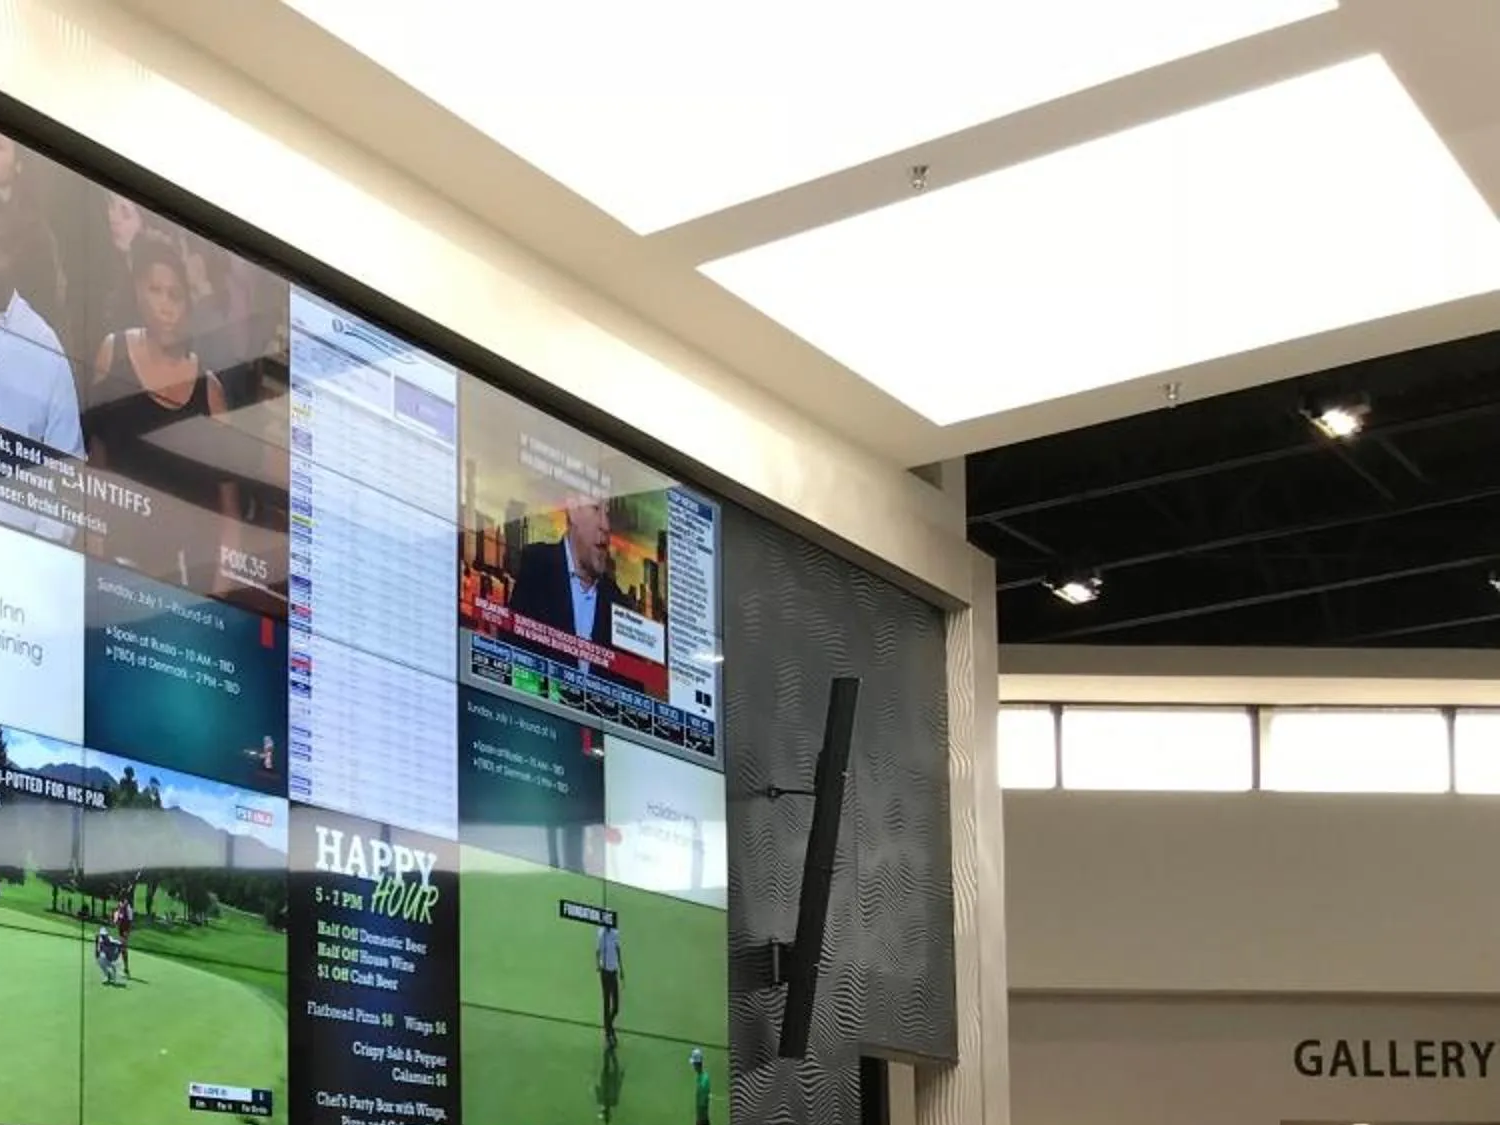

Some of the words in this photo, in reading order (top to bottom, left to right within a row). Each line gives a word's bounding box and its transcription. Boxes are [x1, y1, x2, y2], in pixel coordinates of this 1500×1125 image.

[62, 474, 152, 516] AINTIFFS
[0, 597, 25, 624] Inn
[45, 779, 64, 799] FOR
[67, 787, 82, 802] HIS
[315, 825, 437, 891] HAPPY
[315, 887, 323, 902] 5
[342, 891, 363, 911] PM
[371, 875, 439, 924] HOUR
[317, 920, 339, 937] Half
[342, 927, 359, 941] Off
[360, 929, 404, 949] Domestic
[317, 941, 339, 959] Half
[342, 949, 359, 962] Off
[360, 950, 389, 968] House
[390, 955, 415, 972] Wine
[317, 963, 329, 978] $1
[332, 967, 348, 981] Off
[376, 973, 398, 990] Beer
[307, 1001, 354, 1021] Flatbread
[356, 1008, 380, 1025] Pizza
[404, 1015, 434, 1036] Wings
[353, 1041, 385, 1061] Crispy
[387, 1046, 404, 1061] Salt
[415, 1050, 447, 1068] Pepper
[1294, 1039, 1495, 1078] GALLERY
[392, 1067, 434, 1085] Calamari
[316, 1091, 347, 1108] Chef's
[350, 1095, 374, 1114] Party
[376, 1098, 394, 1112] Box
[395, 1102, 414, 1115] with
